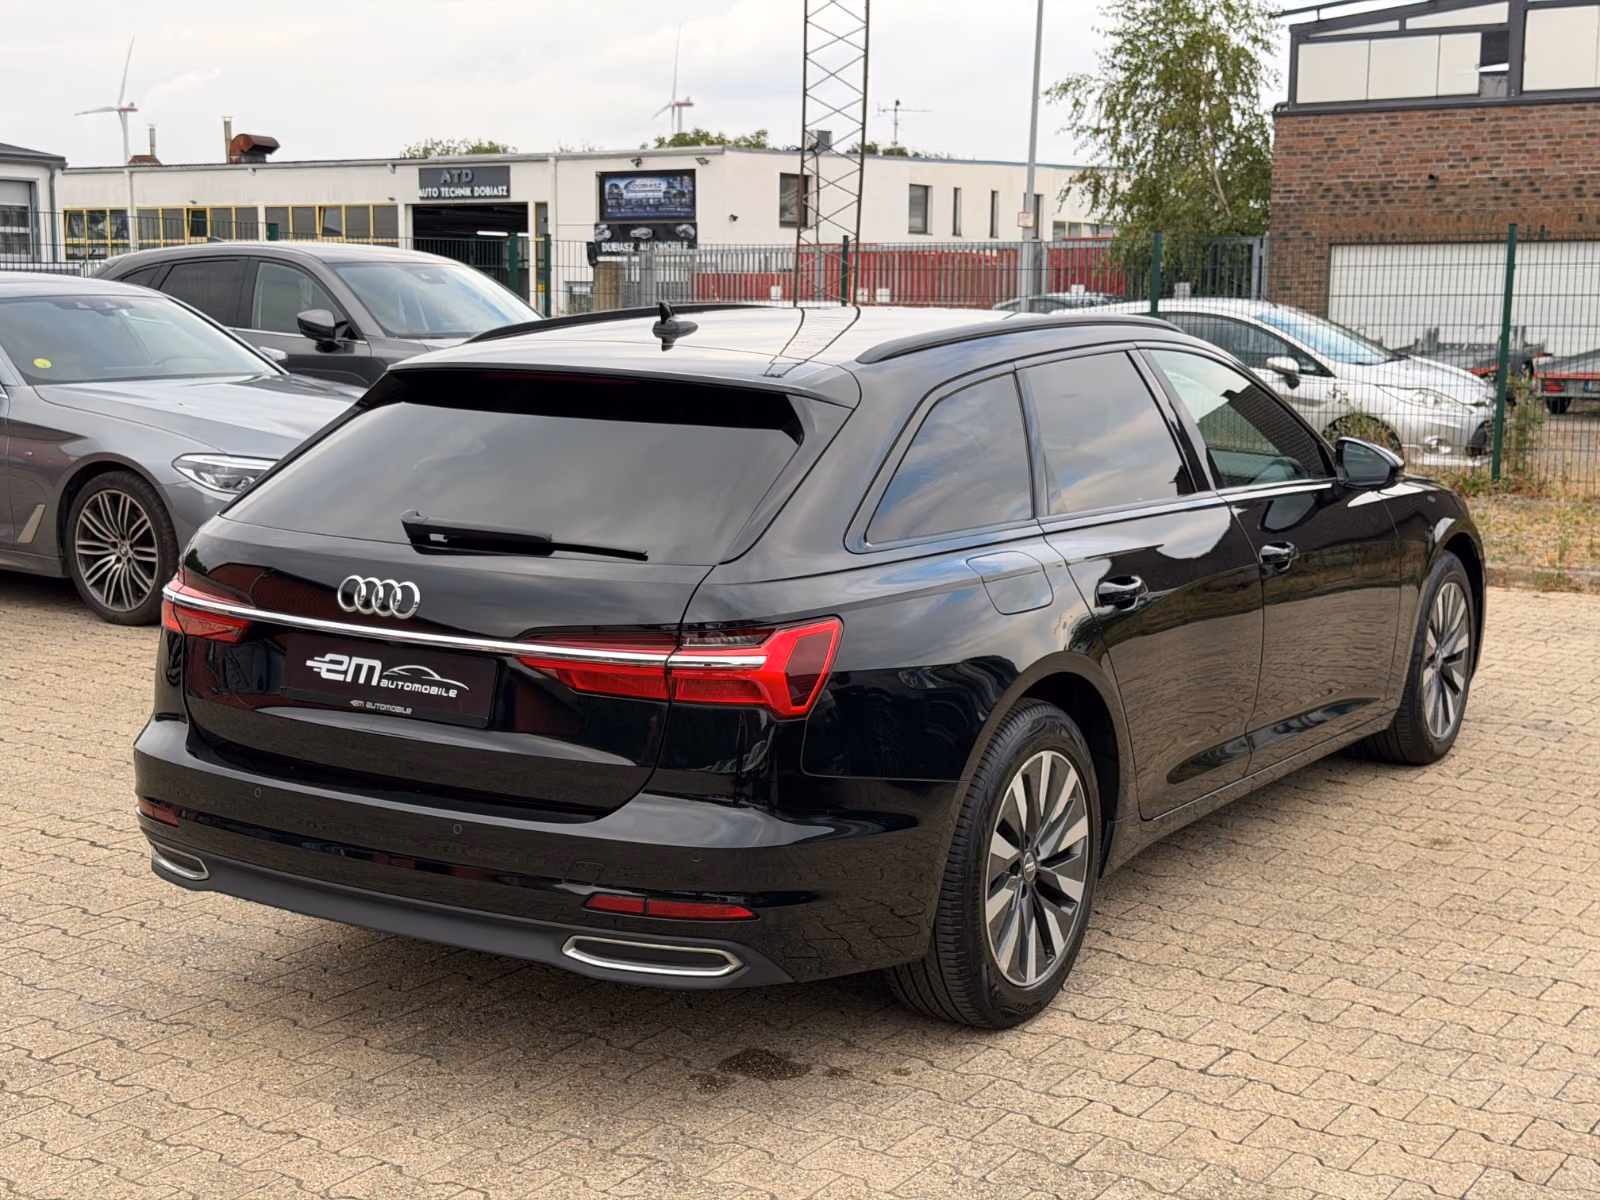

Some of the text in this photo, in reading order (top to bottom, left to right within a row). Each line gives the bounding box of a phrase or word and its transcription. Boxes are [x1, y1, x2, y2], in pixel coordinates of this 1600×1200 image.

[441, 168, 473, 184] ATD
[418, 185, 508, 198] AUTO TECHNIK DOBIASZ
[601, 240, 689, 252] DOBIASZ AUOMOBILE
